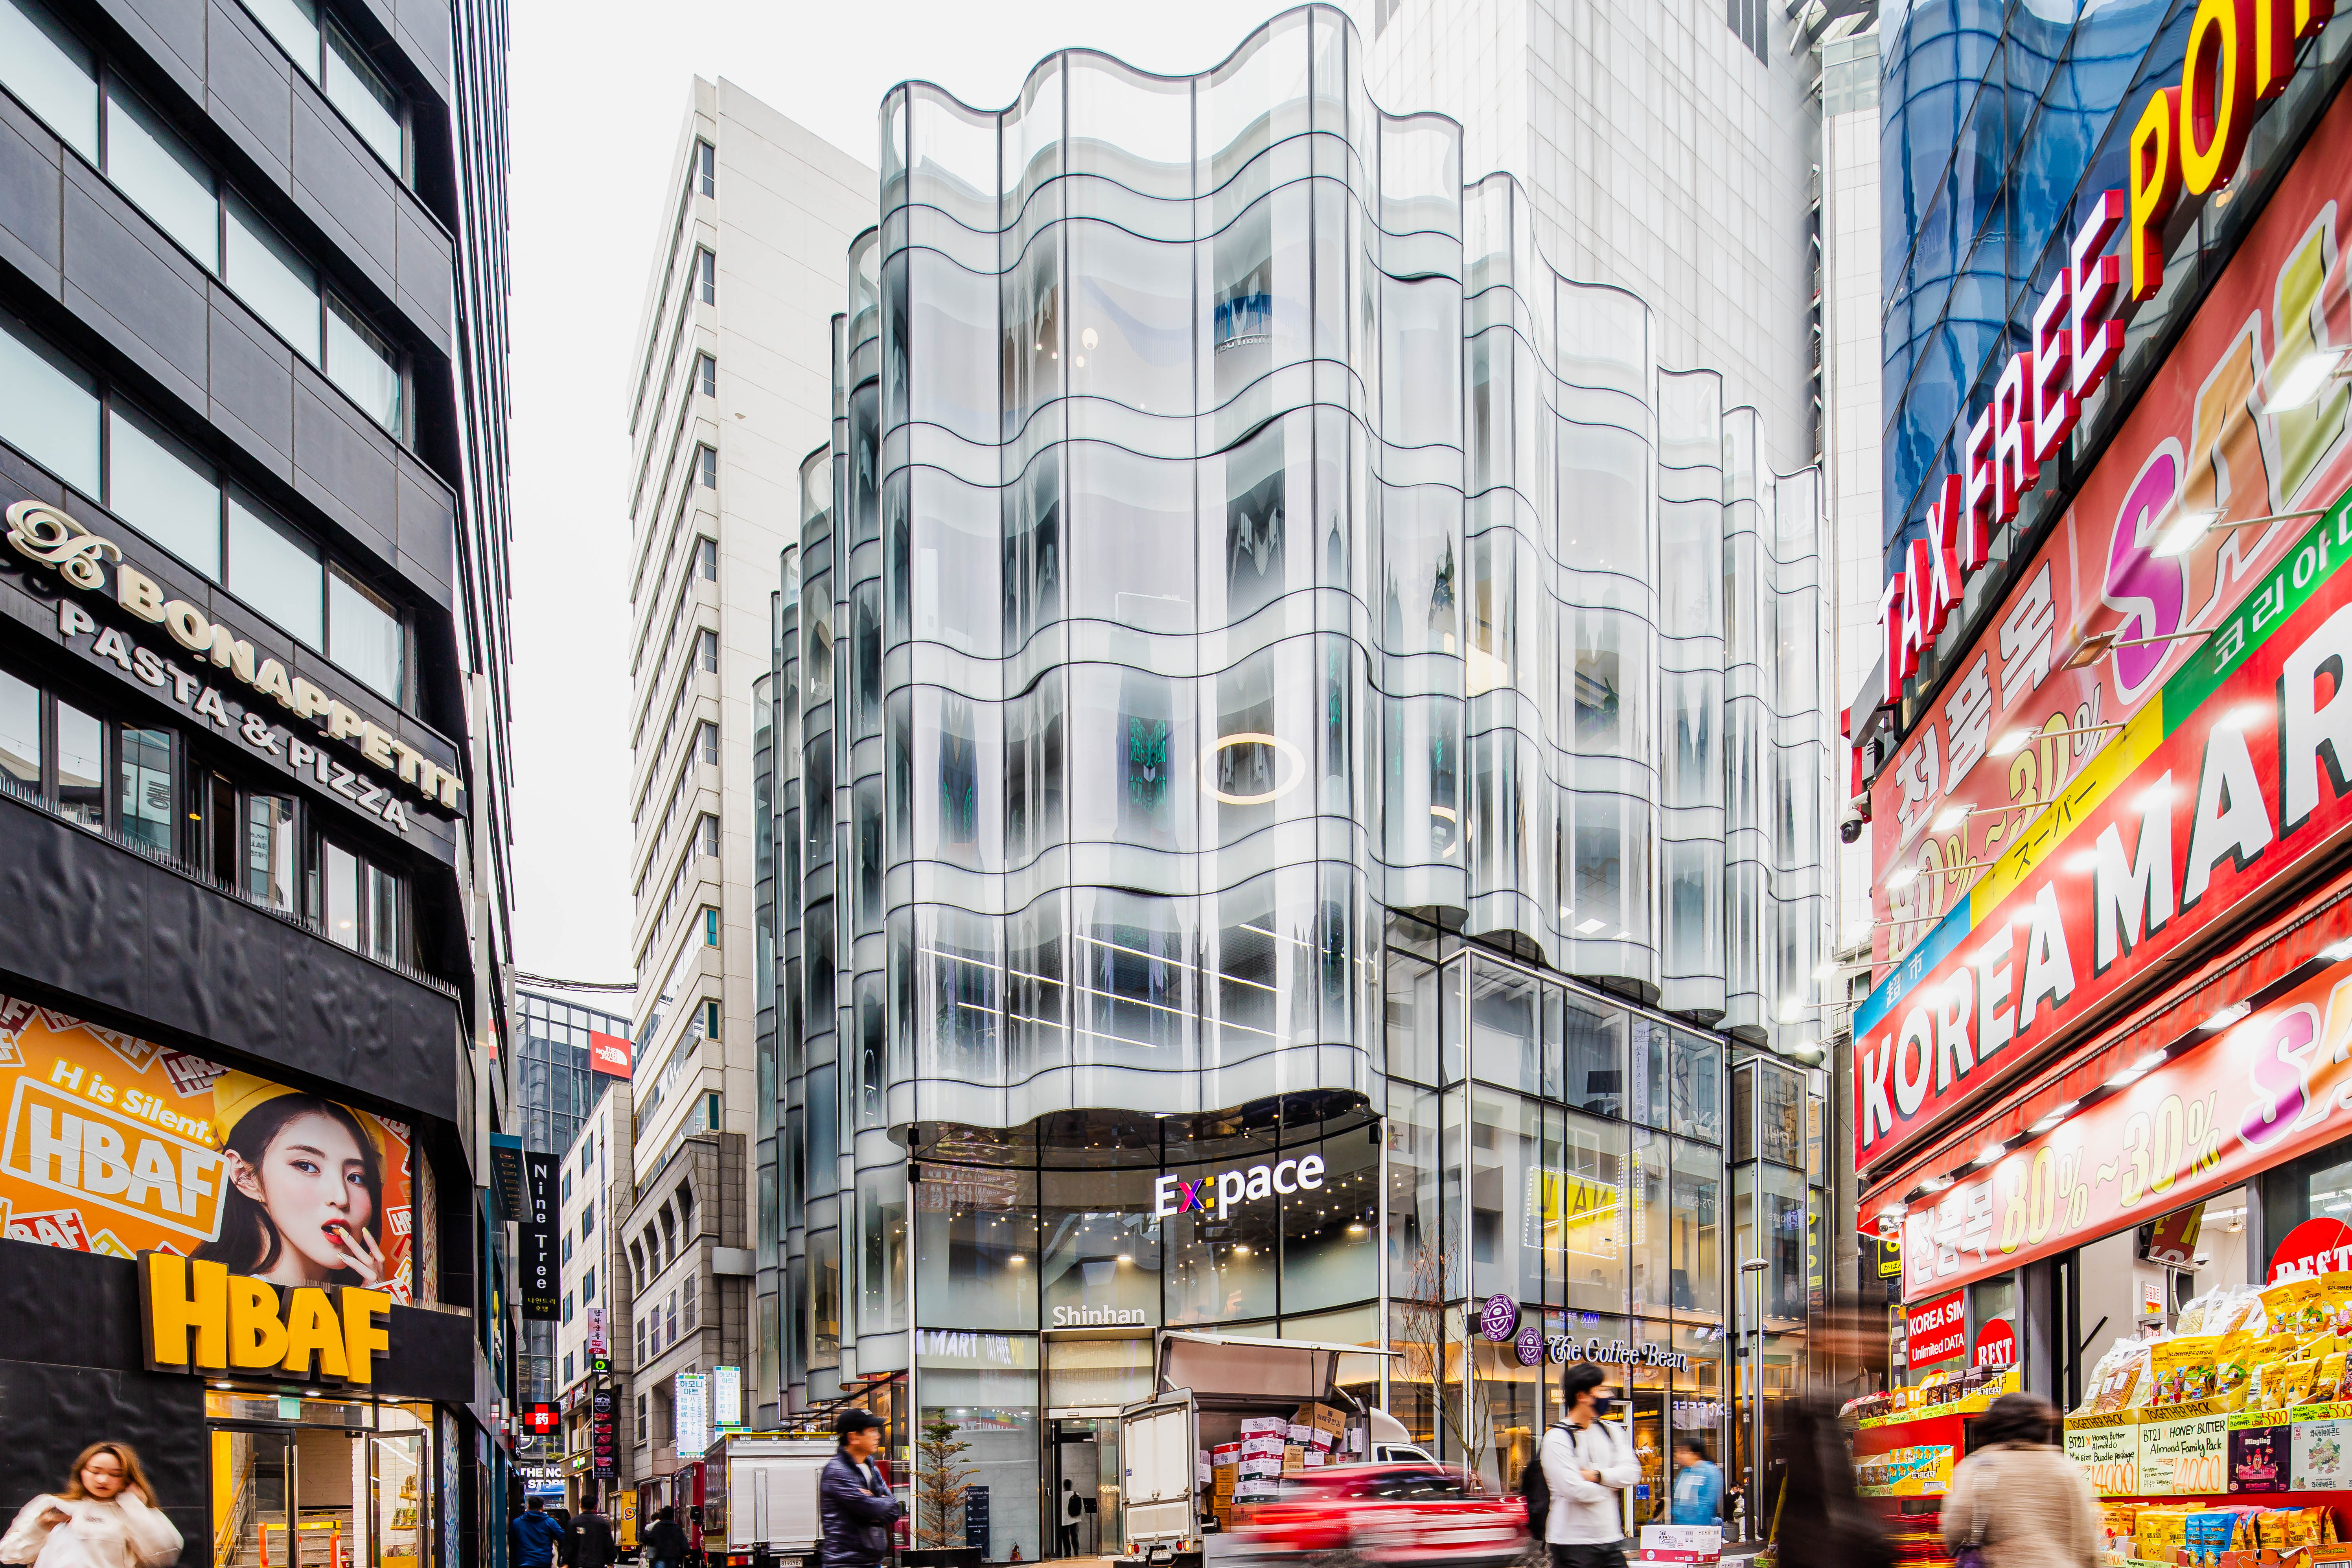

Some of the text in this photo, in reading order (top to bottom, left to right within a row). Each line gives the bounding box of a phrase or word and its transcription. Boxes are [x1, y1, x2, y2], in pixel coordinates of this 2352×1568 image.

[1877, 0, 2335, 705] TAX FREE POI
[2102, 199, 2352, 706] SAL
[118, 563, 464, 809] BONAPPETIT
[59, 599, 410, 832] PASTA & PIZZA
[1895, 558, 2056, 851] 전품목
[2014, 780, 2096, 880] スーパー
[1863, 600, 2352, 1148] KOREA MAR
[1886, 949, 1924, 1009] 超市
[596, 1048, 617, 1057] NORTH
[600, 1054, 617, 1063] FACE
[51, 1059, 215, 1143] H is Silent.
[30, 1103, 218, 1217] HBAF
[534, 1164, 548, 1288] Nine Tree
[1910, 1178, 1993, 1285] 전품목
[1053, 1305, 1145, 1327] Shinhan
[1487, 1296, 1502, 1308] Coffee
[1503, 1297, 1512, 1314] Bean
[149, 1252, 391, 1384] HBAF
[1910, 1298, 1965, 1337] KOREA SIM
[1498, 1323, 1509, 1337] Leaf
[1547, 1335, 1689, 1373] The Coffee Bean
[1912, 1333, 1965, 1362] Unlimited DATA
[1977, 1337, 2012, 1366] BEST
[1976, 1387, 2002, 1397] 투게더팩
[535, 1412, 548, 1425] 药
[2105, 1414, 2126, 1426] PACK
[2185, 1402, 2214, 1416] PACK
[2261, 1410, 2288, 1426] 5500
[681, 1422, 688, 1435] 超市
[1316, 1413, 1341, 1431] 파래광천김
[2143, 1428, 2161, 1443] BT21
[2170, 1424, 2196, 1439] HONEY
[2197, 1419, 2226, 1434] BUTTER
[2310, 1427, 2341, 1437] 와사비맛아몬드
[2069, 1435, 2085, 1449] BT21
[2092, 1434, 2108, 1444] Honey
[2109, 1431, 2126, 1441] Butter
[2091, 1442, 2113, 1451] Almond
[2150, 1438, 2222, 1458] Almond Family Pack
[2244, 1437, 2271, 1446] Mingling
[2070, 1452, 2080, 1463] Mini
[2093, 1452, 2113, 1463] Bundle
[2114, 1449, 2135, 1467] package
[520, 1468, 543, 1477] THE
[1911, 1470, 1936, 1480] 투게더팩
[2091, 1462, 2134, 1494] 14000
[2172, 1454, 2221, 1494] 14000
[2105, 1553, 2123, 1565] 6900
